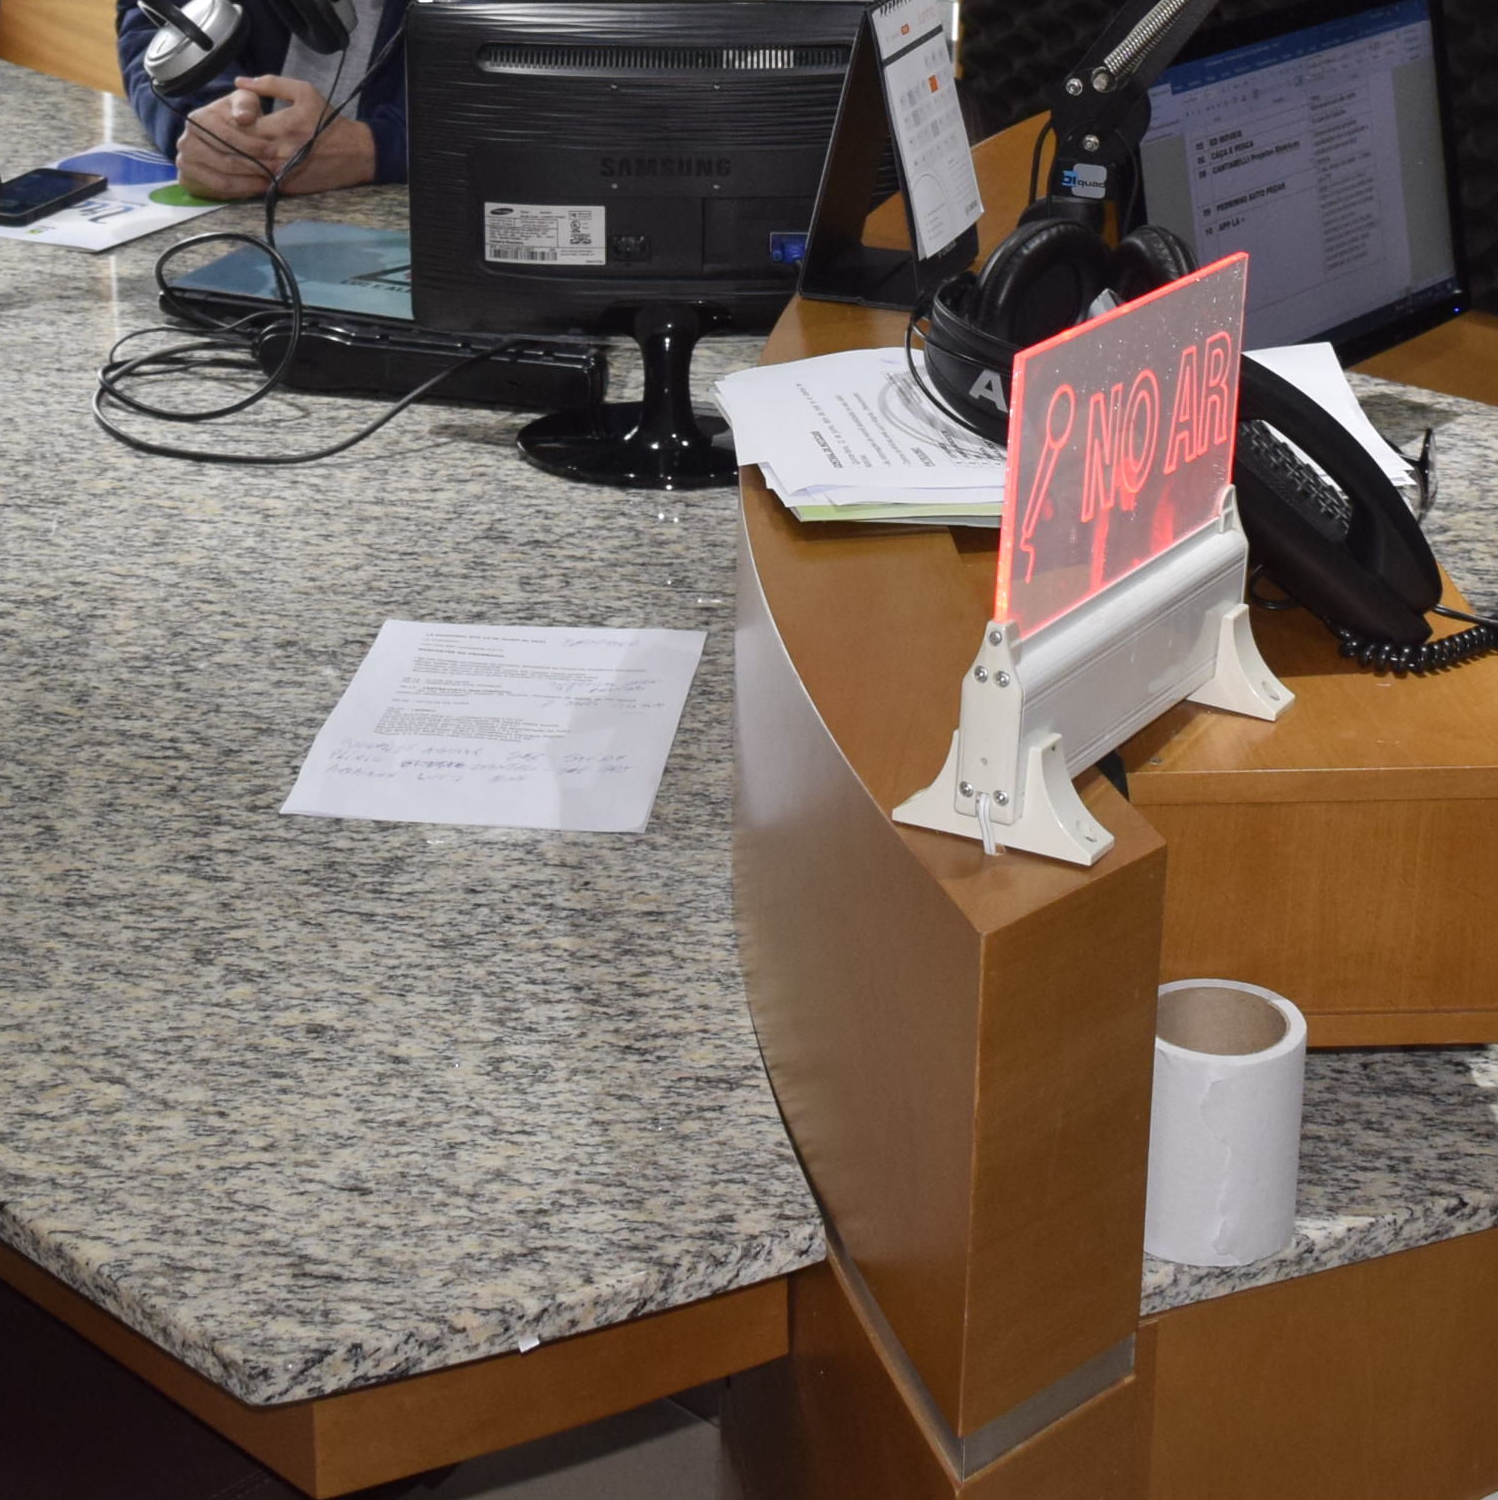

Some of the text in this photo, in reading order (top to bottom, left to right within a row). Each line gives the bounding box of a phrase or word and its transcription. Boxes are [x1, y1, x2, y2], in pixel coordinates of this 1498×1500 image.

[600, 156, 733, 177] SAMSUNG
[1081, 368, 1160, 523] NO
[1164, 331, 1234, 475] AR
